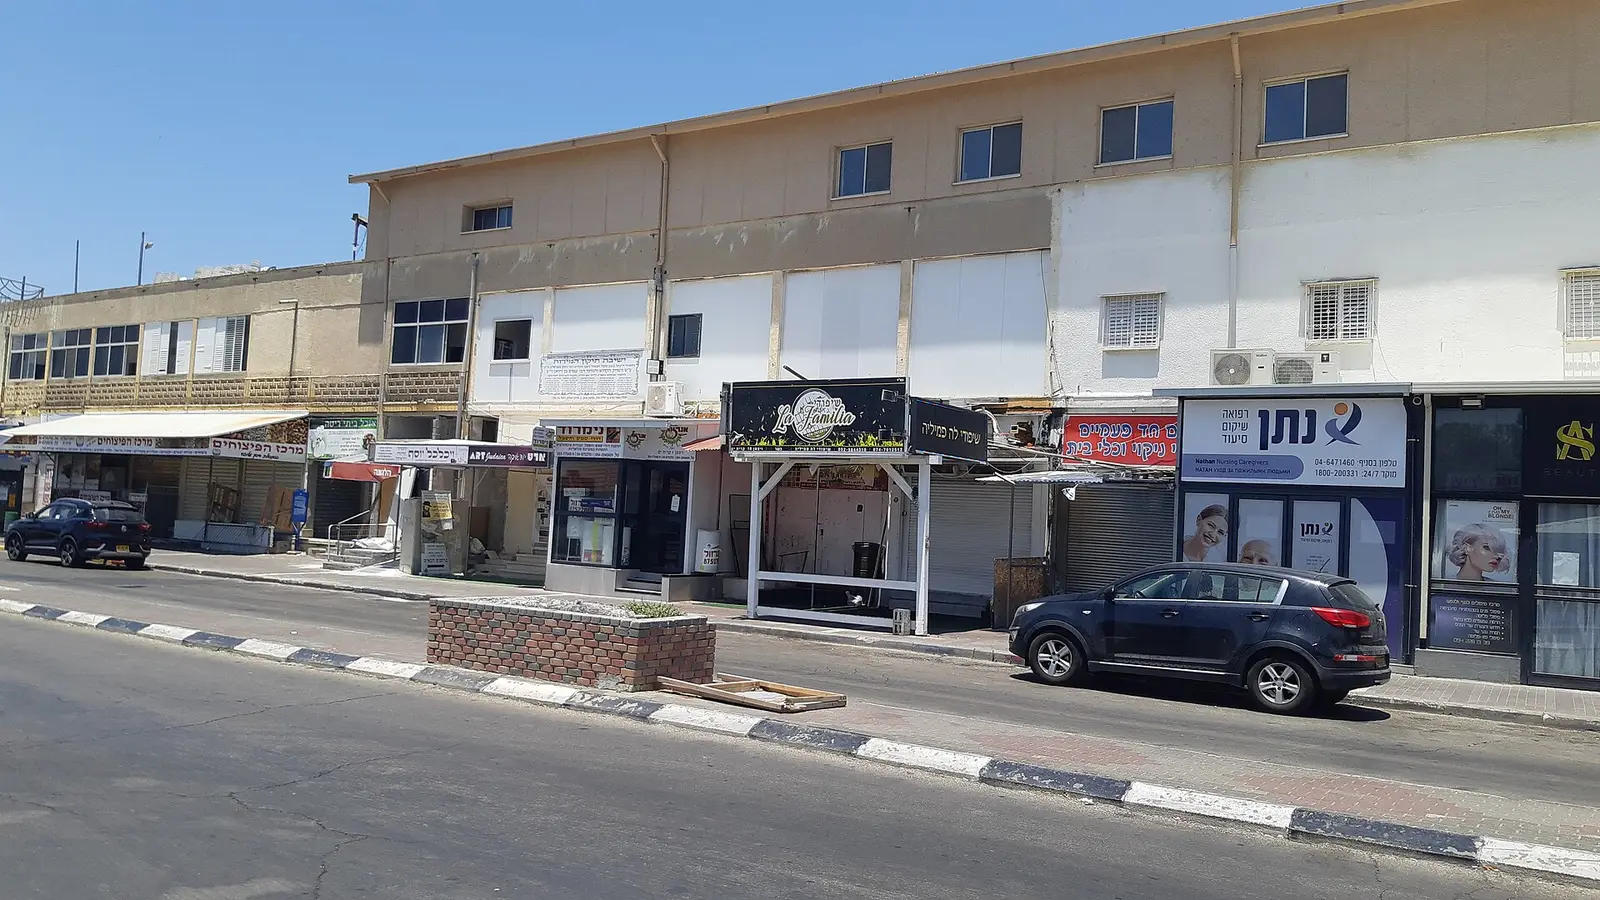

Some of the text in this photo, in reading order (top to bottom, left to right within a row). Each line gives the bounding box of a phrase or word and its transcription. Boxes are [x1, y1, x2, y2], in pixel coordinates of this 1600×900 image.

[772, 404, 856, 434] La Familia
[1222, 409, 1249, 419] רפואה
[360, 418, 377, 427] אוכל
[1222, 422, 1249, 432] שיקום
[556, 426, 604, 435] נימרוד
[921, 421, 981, 445] שיפודי לה פמיליה
[1079, 422, 1132, 438] פעמיים
[1138, 423, 1160, 438] חד
[1258, 409, 1317, 451] נתן
[97, 437, 132, 447] הפיצוחים
[134, 438, 153, 447] מרכז
[1222, 434, 1248, 444] סיעוד
[212, 439, 272, 453] הפיצוחים
[276, 444, 304, 455] מרכז
[1066, 441, 1092, 455] בית
[1097, 438, 1127, 456] וכלי
[470, 452, 486, 460] ART
[1132, 442, 1166, 461] ניקוי
[1216, 458, 1238, 466] Nursing
[1314, 458, 1397, 467] טלפון בסניף: 04-6471460
[1314, 469, 1359, 477] 1800-200331
[1300, 523, 1320, 537] נתן
